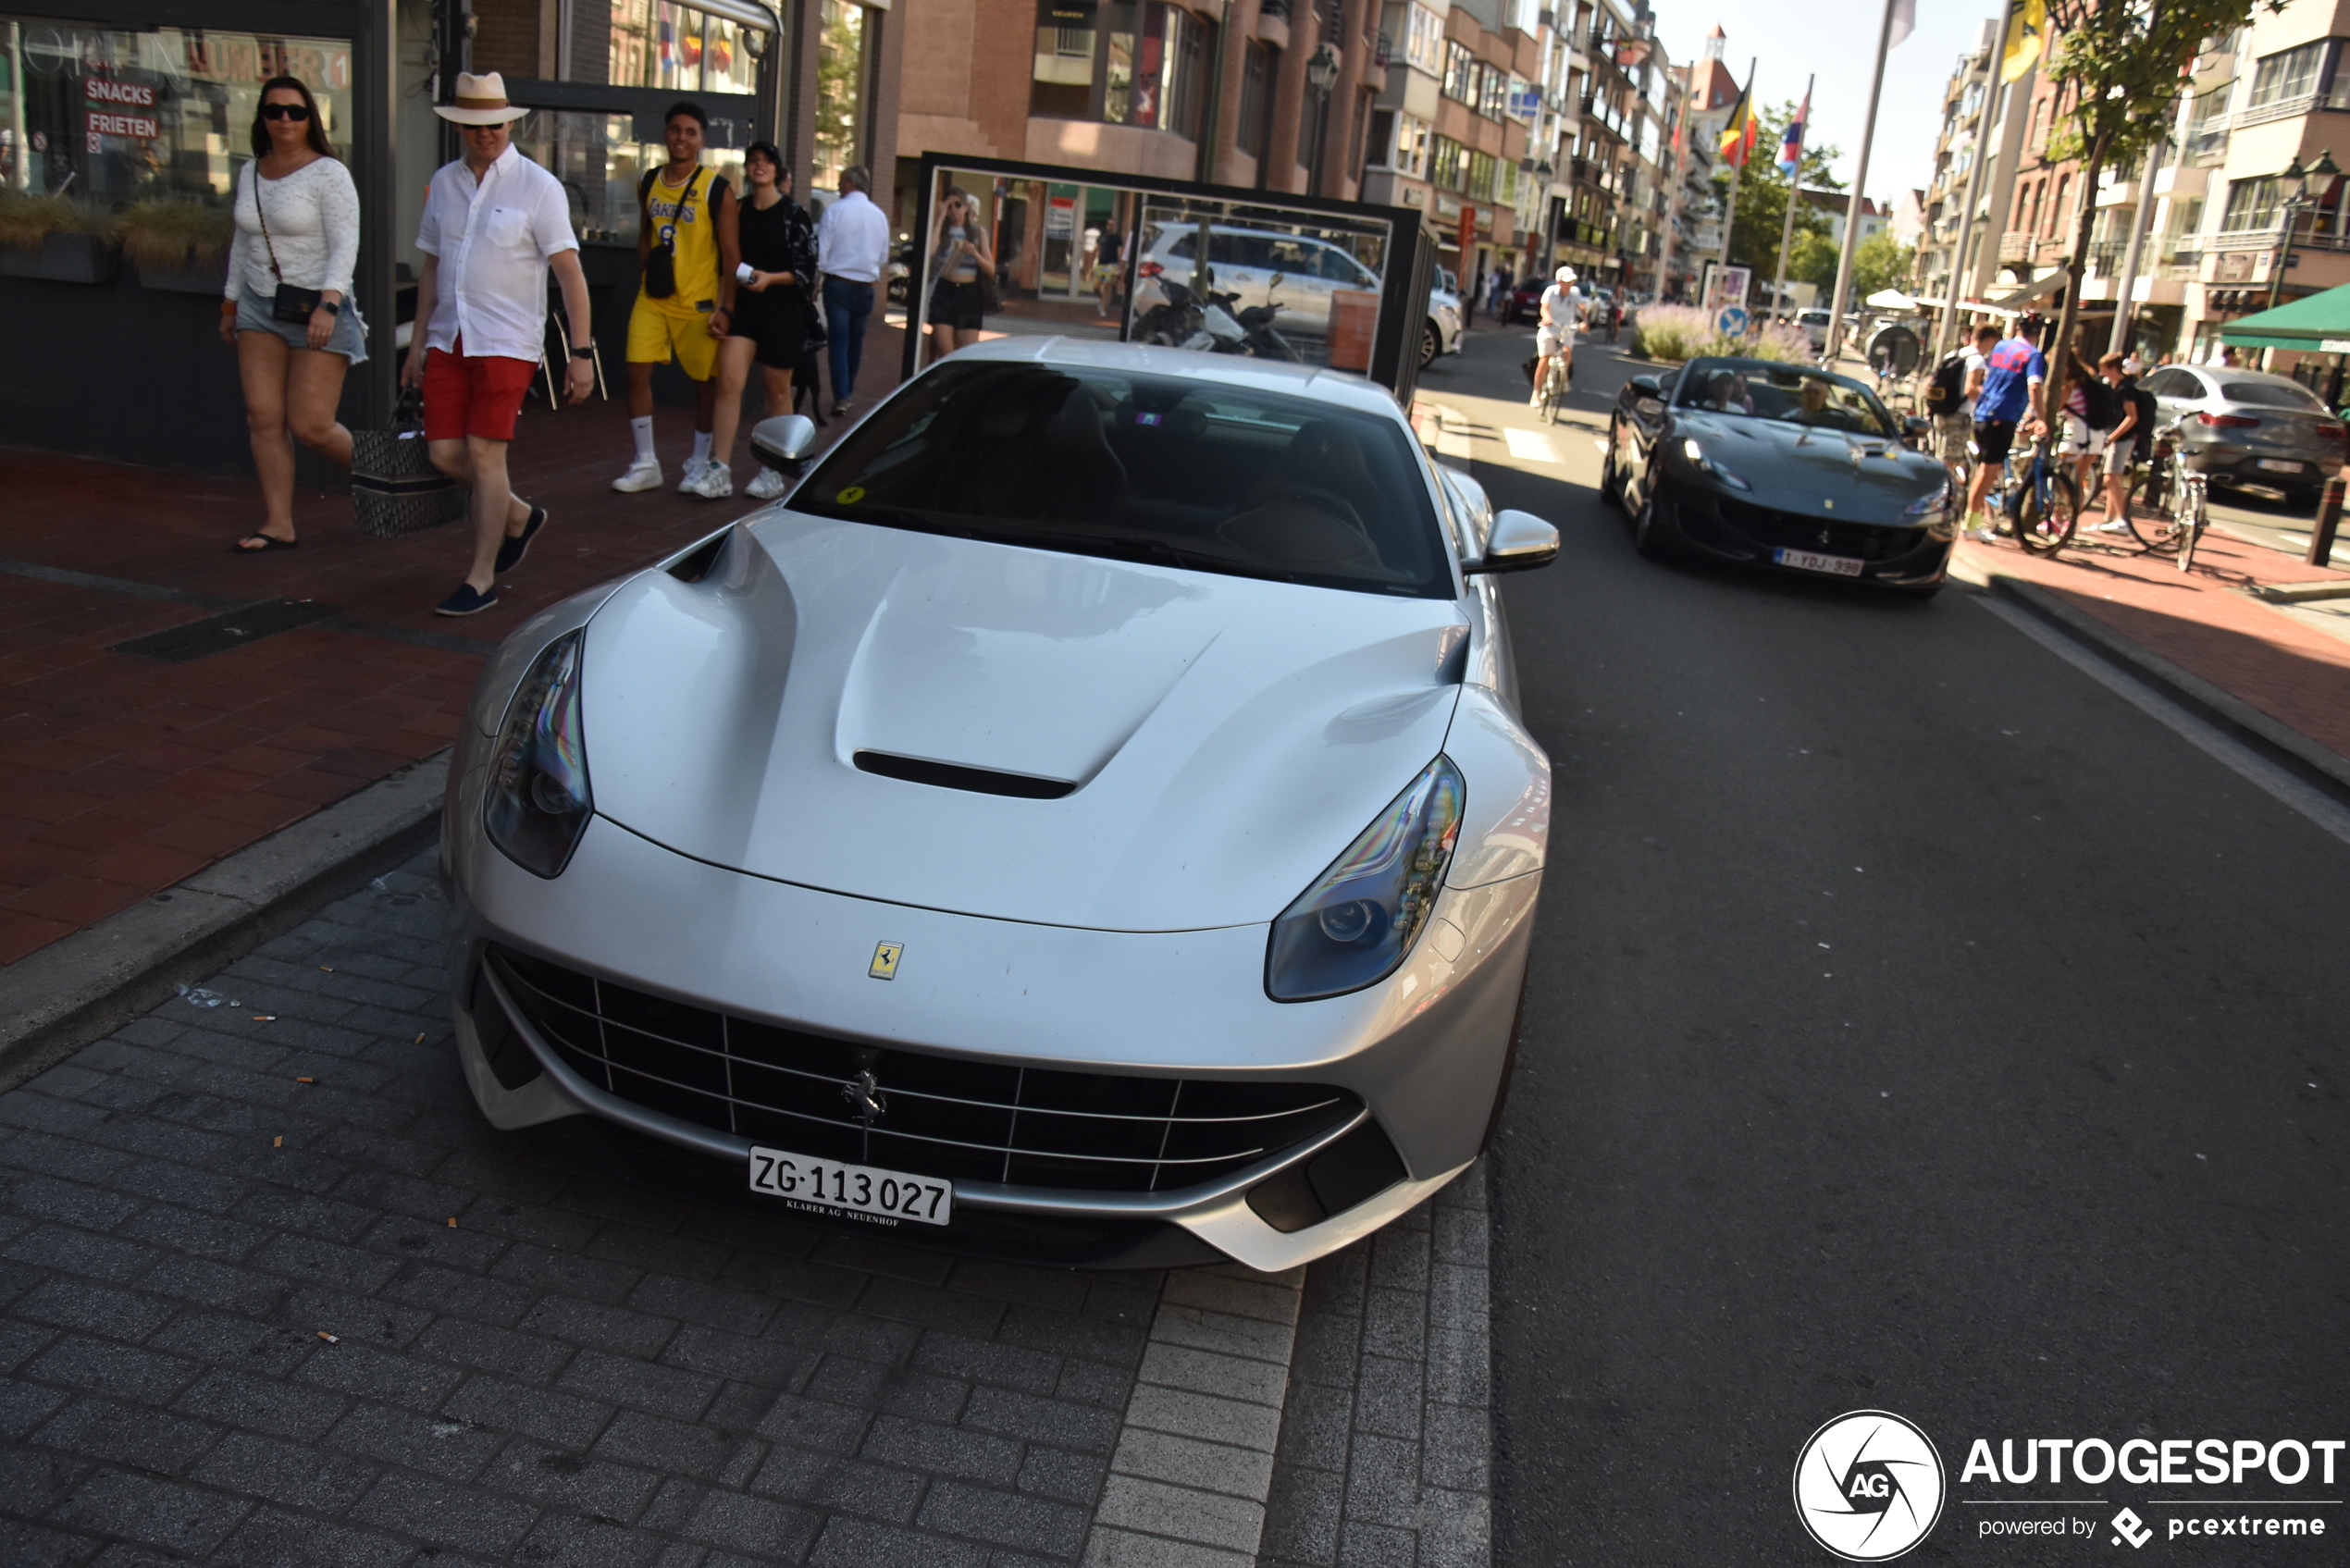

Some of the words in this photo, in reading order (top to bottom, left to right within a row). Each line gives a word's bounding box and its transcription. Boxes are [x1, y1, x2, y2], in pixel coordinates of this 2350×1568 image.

[86, 80, 153, 105] SNACKS
[89, 113, 157, 138] FRIETEN
[786, 1200, 825, 1214] KLARER
[827, 1208, 841, 1216] AG
[847, 1211, 899, 1227] NEUENHOF
